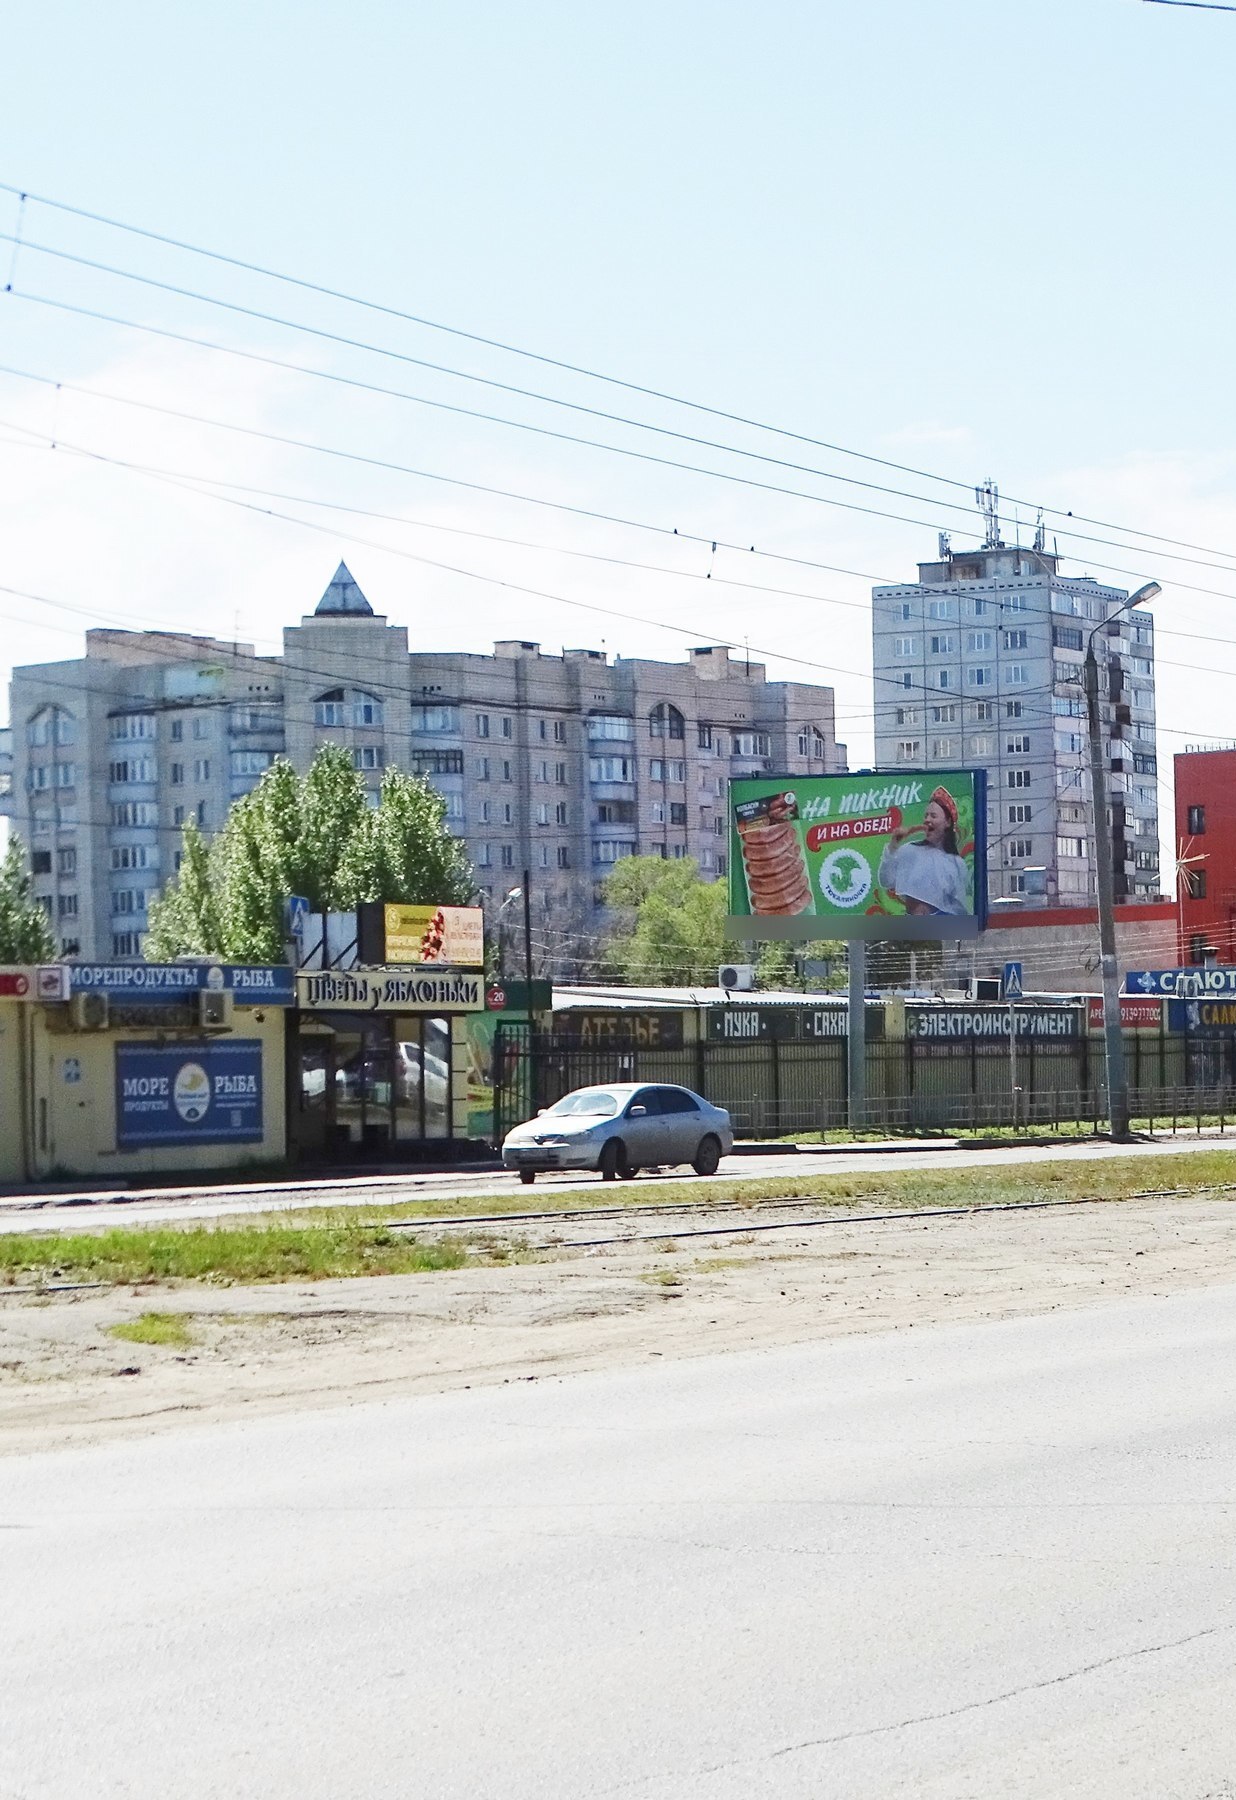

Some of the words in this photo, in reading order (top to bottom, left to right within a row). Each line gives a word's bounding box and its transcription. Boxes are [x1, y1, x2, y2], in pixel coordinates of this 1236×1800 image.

[803, 796, 830, 821] НА
[817, 829, 827, 839] И
[831, 826, 850, 838] НА
[853, 816, 892, 835] ОБЕД!
[69, 966, 198, 988] МОРЕПРОДУКТЫ
[232, 970, 275, 987] РЫБА
[308, 978, 368, 1006] ЦВЕТЫ
[724, 1011, 759, 1037] МУКА
[814, 1011, 849, 1036] САХА
[918, 1013, 1074, 1036] ЭЛЕКТРОИНСТРУМЕНТ
[123, 1078, 169, 1096] МОРЕ
[214, 1075, 257, 1093] РЫБА
